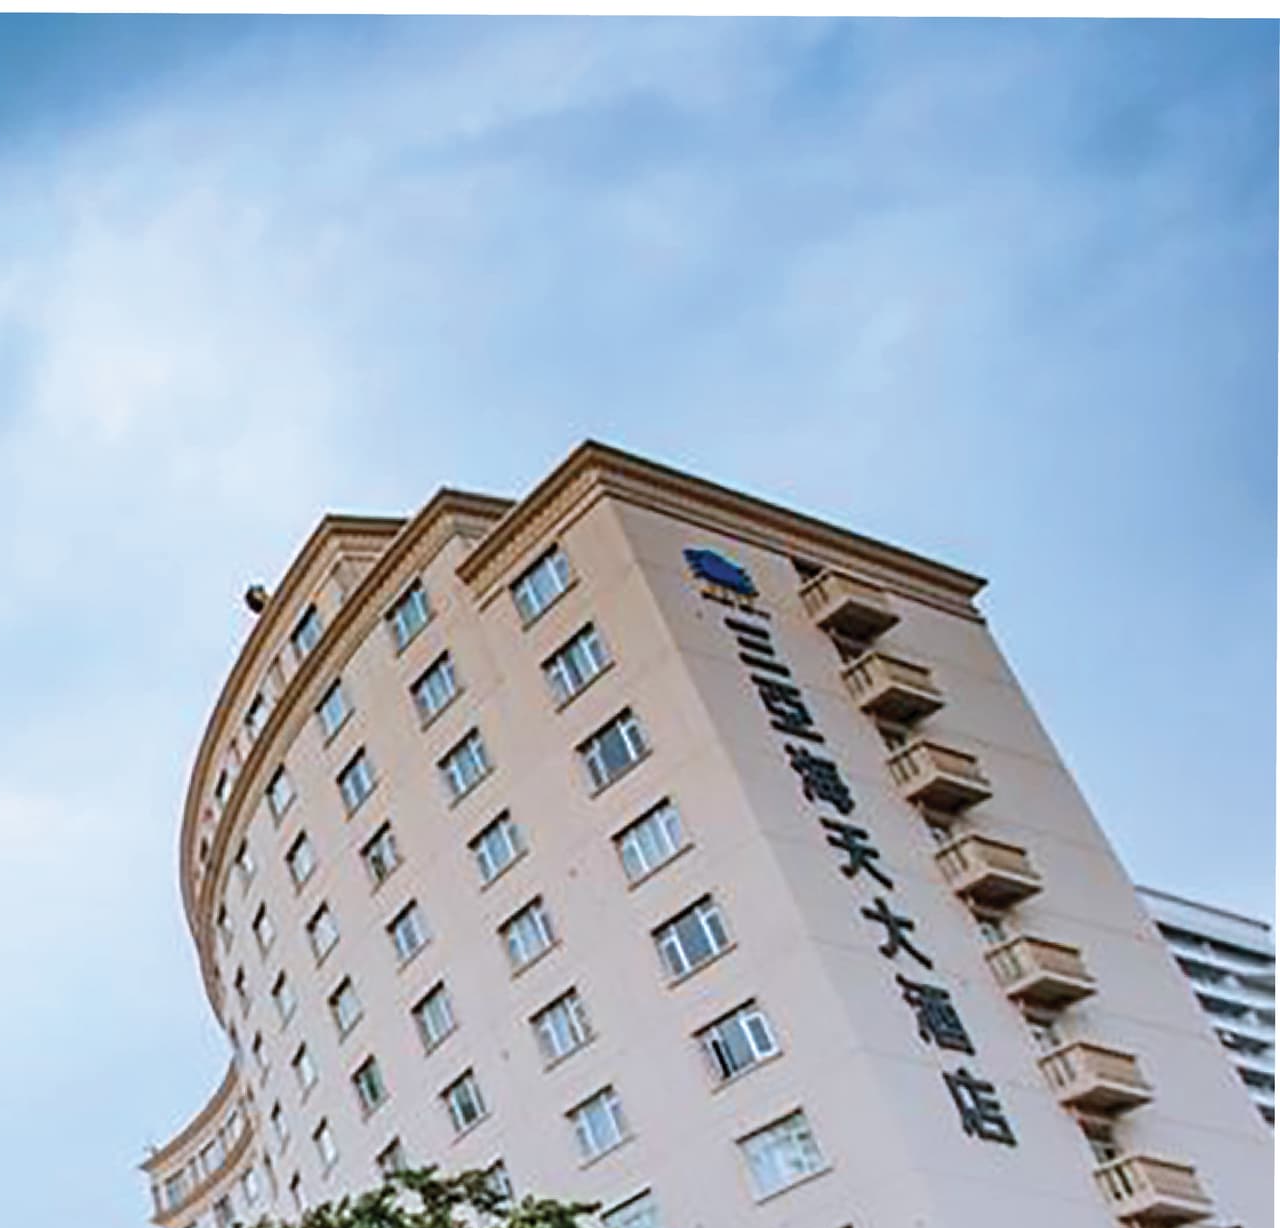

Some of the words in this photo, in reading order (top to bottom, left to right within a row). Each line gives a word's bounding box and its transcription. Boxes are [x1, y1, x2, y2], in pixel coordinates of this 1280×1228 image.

[724, 617, 1018, 1147] 三亚海天大酒店
